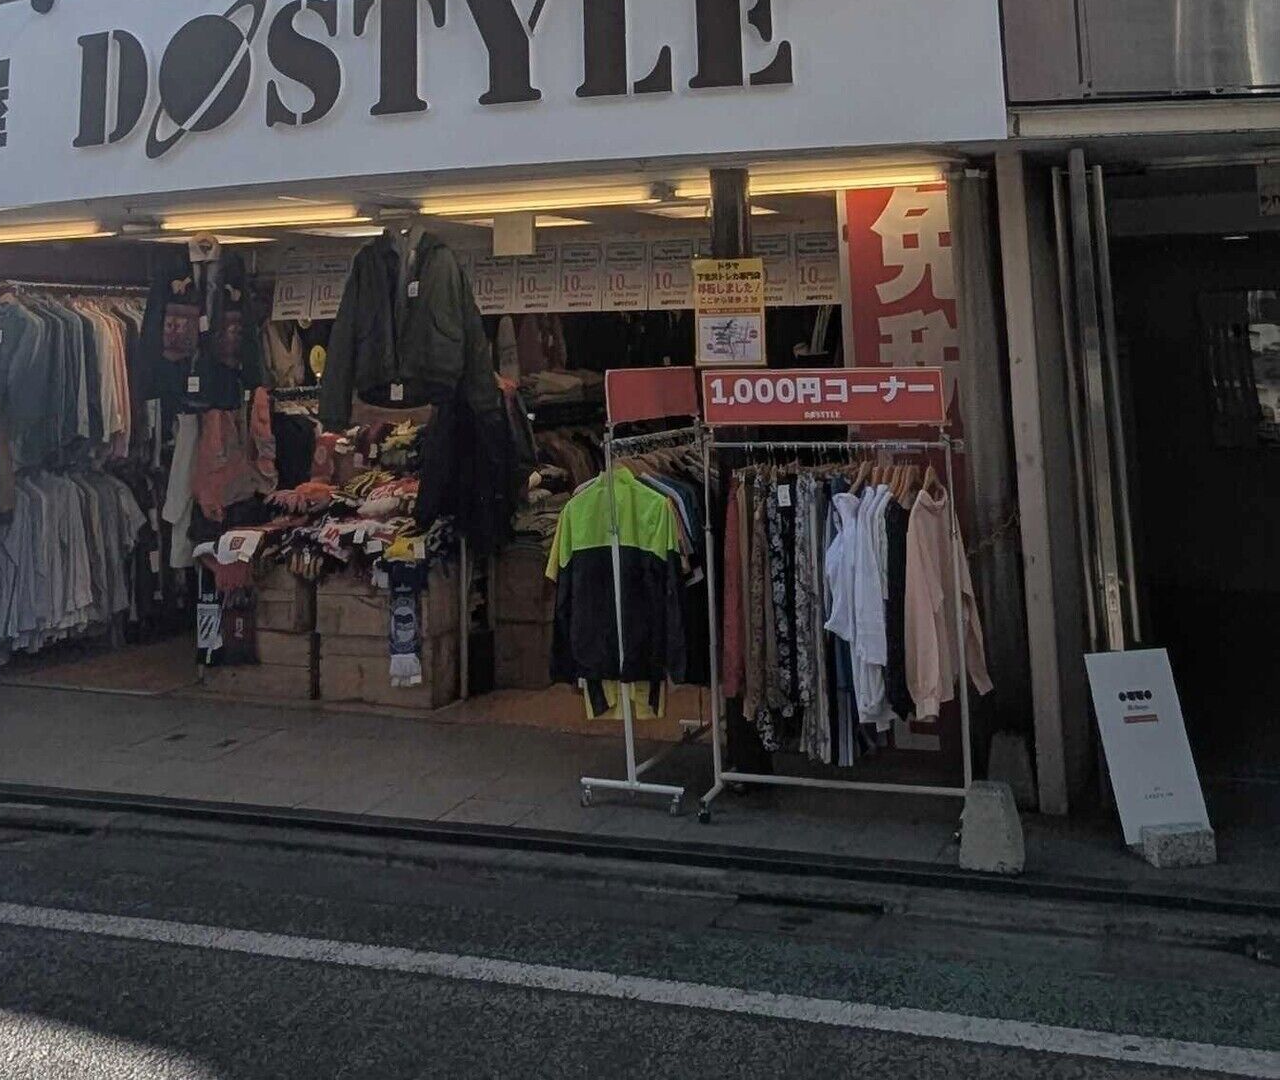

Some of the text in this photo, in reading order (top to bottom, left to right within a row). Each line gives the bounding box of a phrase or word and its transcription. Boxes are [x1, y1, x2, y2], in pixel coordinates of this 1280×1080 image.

[710, 376, 936, 407] 1,000円コーナー
